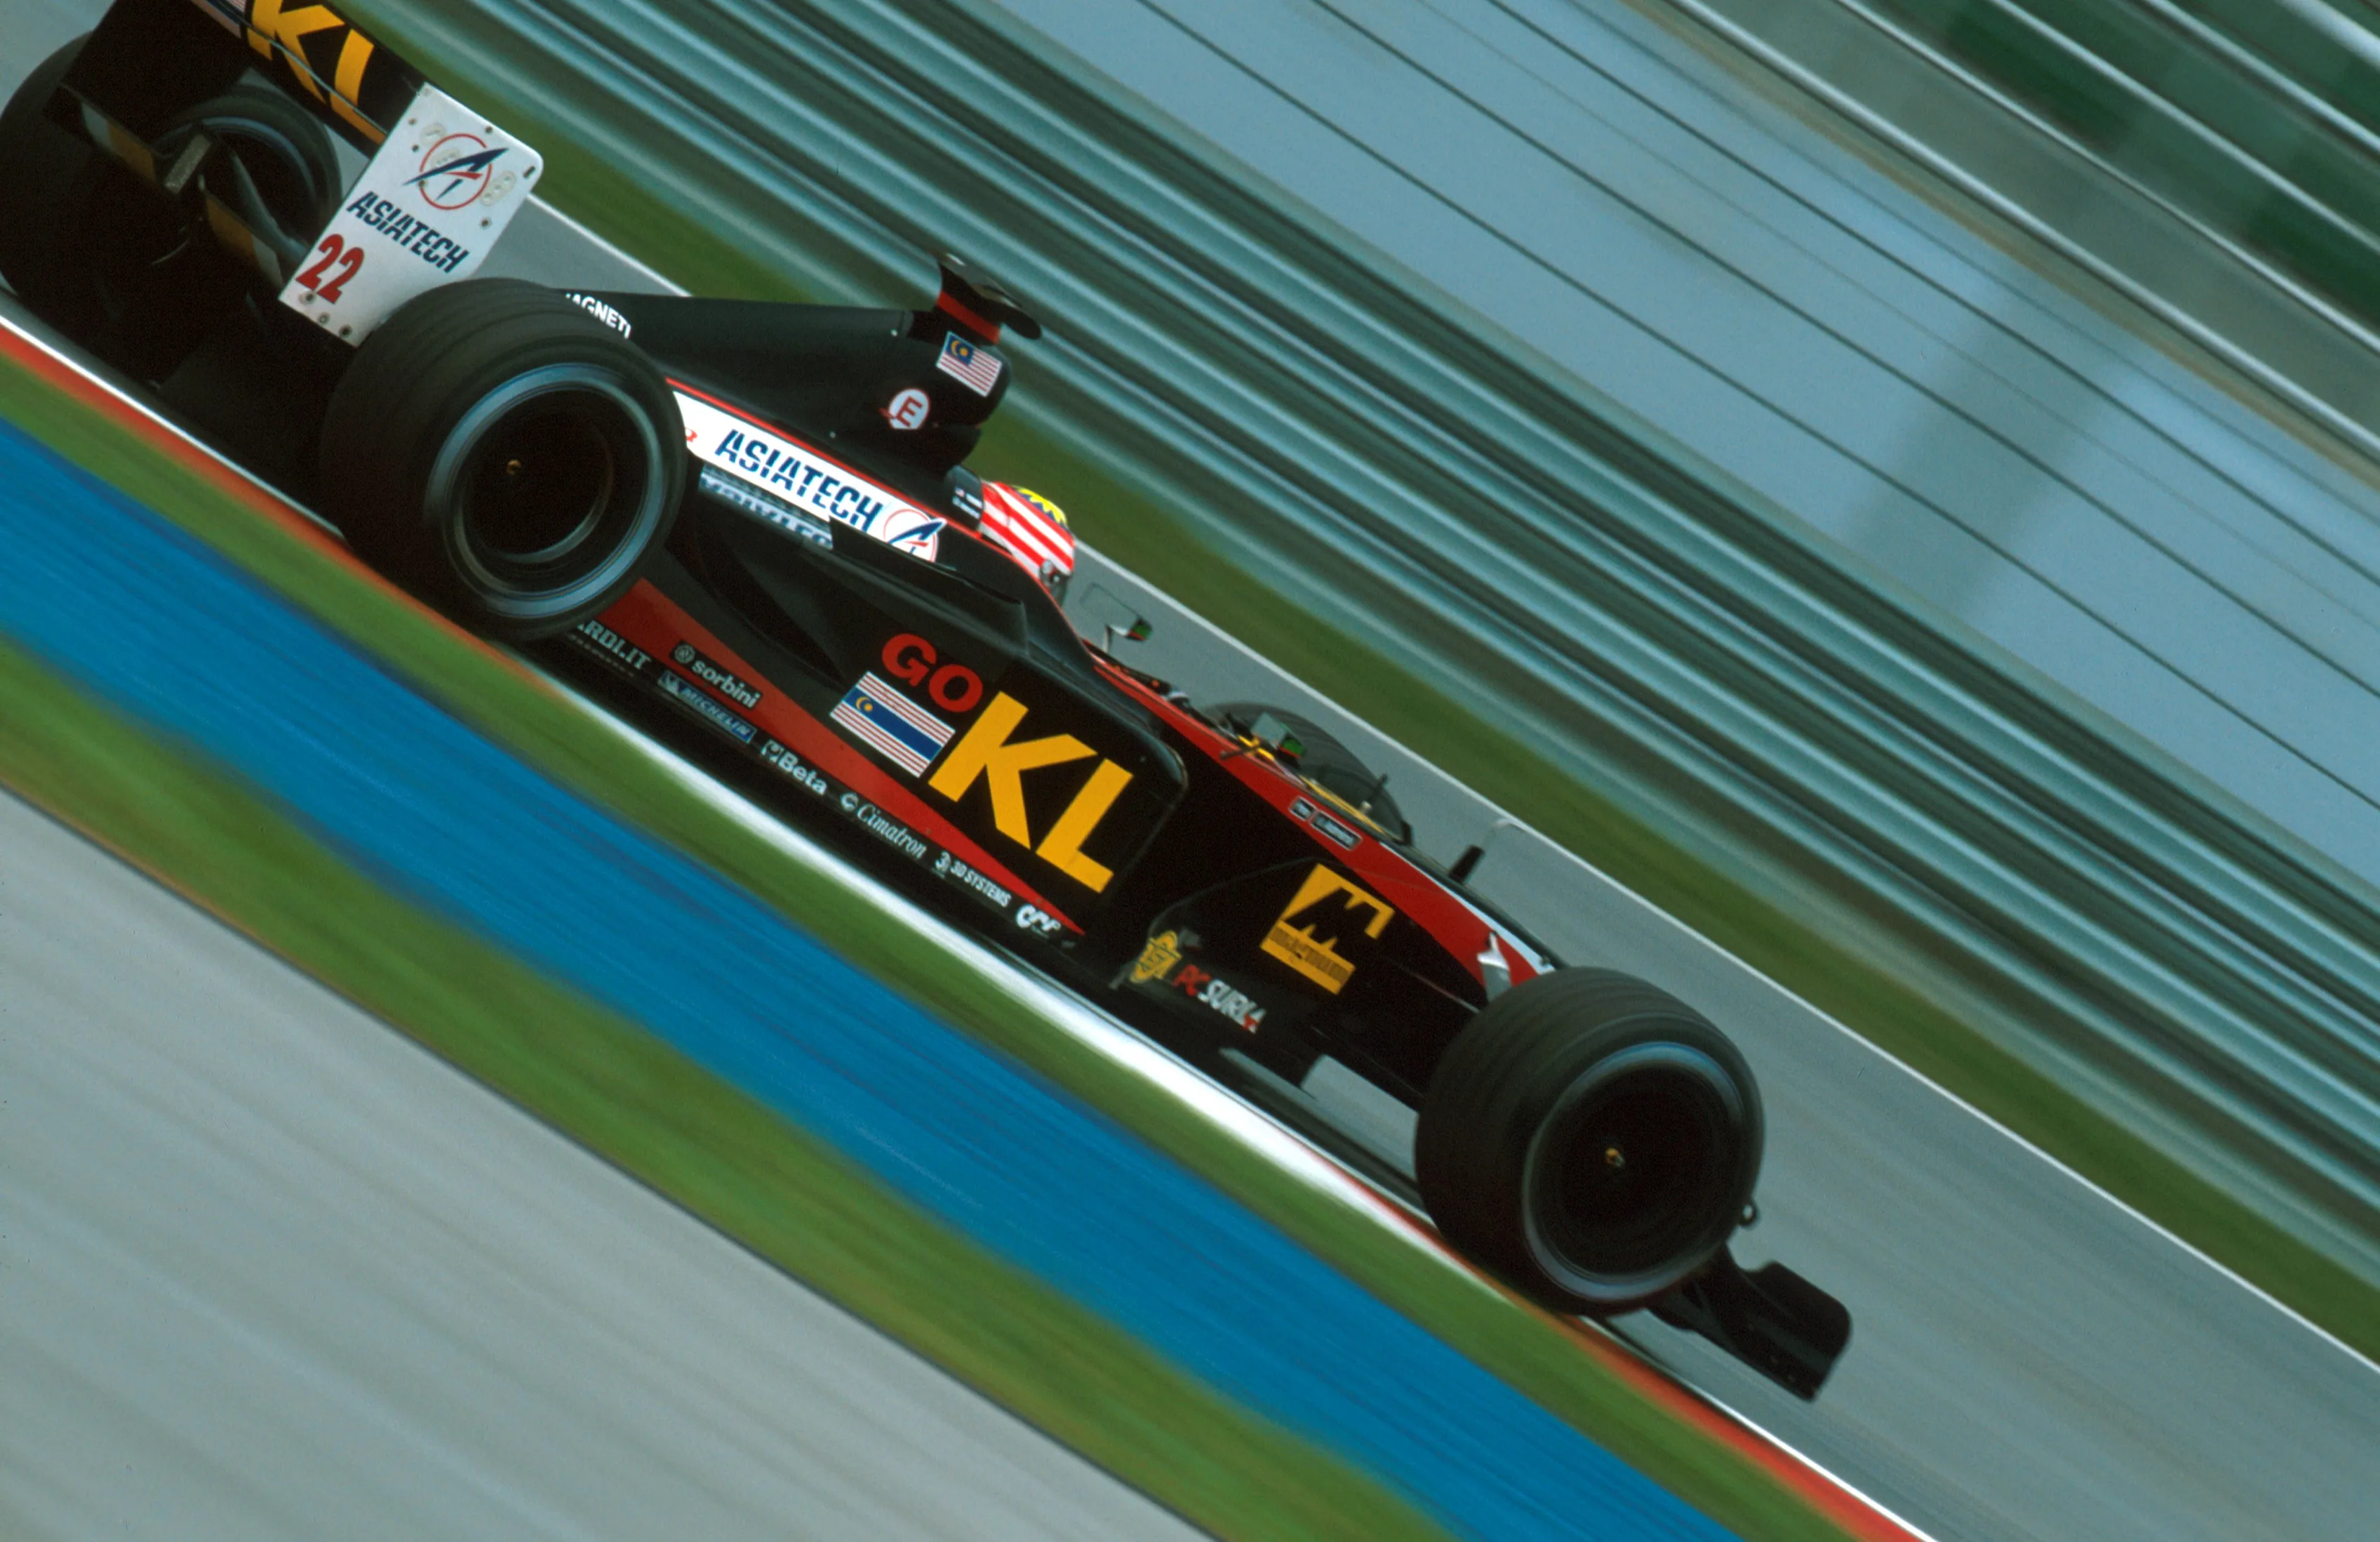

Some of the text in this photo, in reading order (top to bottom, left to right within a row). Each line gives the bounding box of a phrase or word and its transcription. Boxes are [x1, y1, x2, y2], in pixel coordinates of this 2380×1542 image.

[247, 0, 387, 145] KL
[346, 190, 469, 274] ASIATECH
[295, 234, 364, 305] 22
[565, 292, 631, 340] AGNETI
[714, 429, 883, 533] ASIATECH
[577, 620, 651, 670] RDI.IT
[881, 633, 983, 713] GO
[680, 687, 751, 737] MICHELIN
[692, 658, 761, 709] sorbini
[777, 750, 827, 795] Beta
[928, 690, 1135, 893] KL
[857, 803, 927, 859] Cimatron
